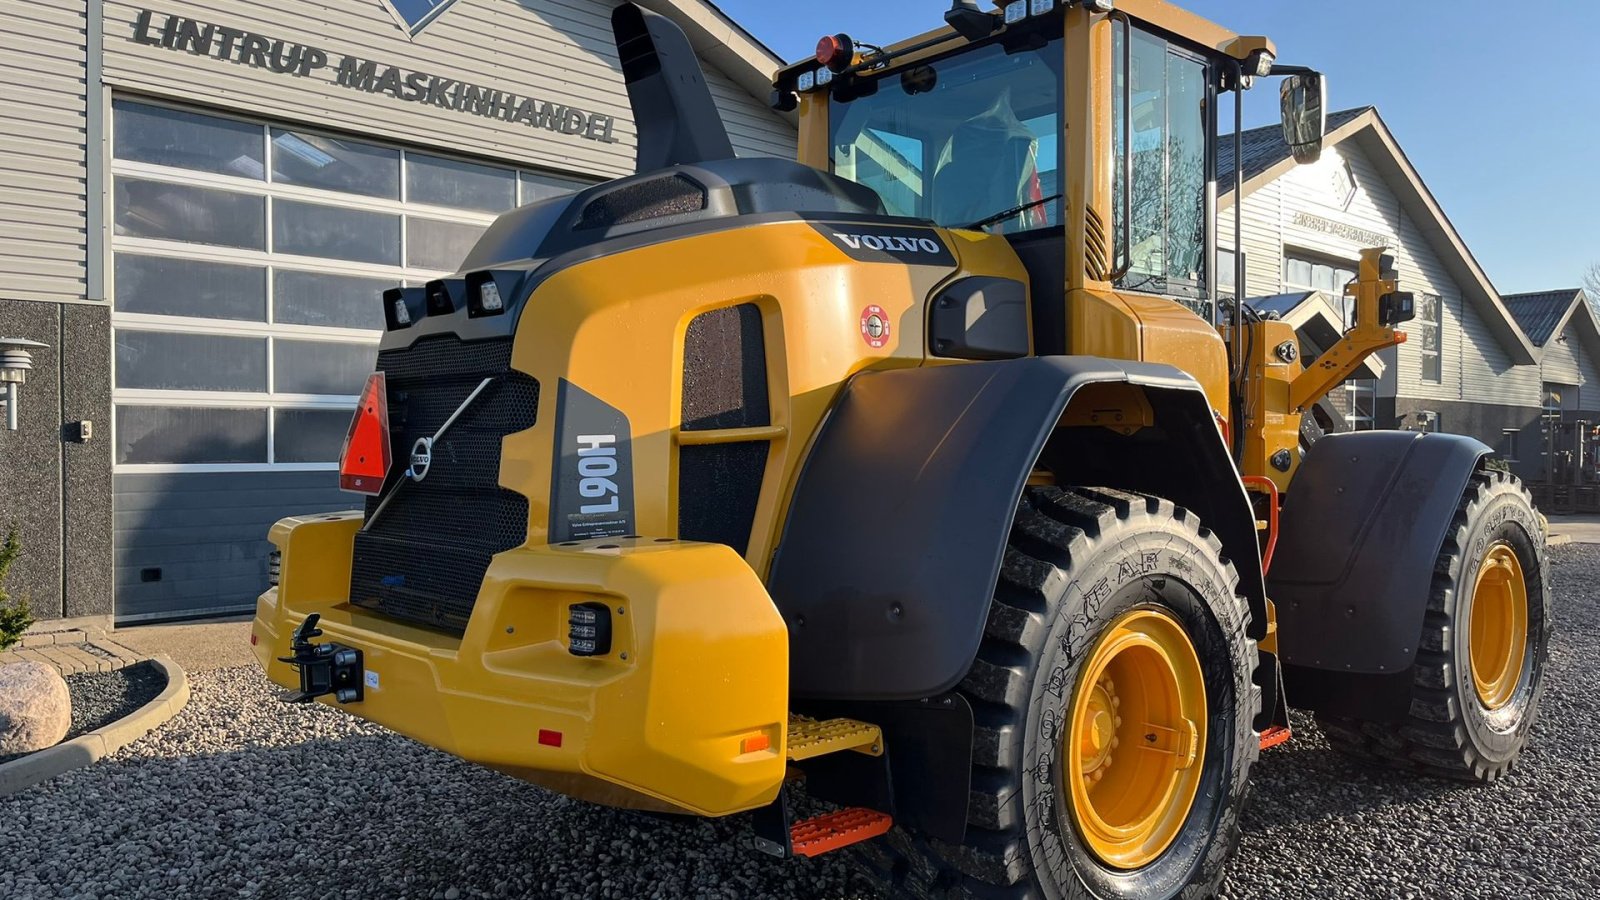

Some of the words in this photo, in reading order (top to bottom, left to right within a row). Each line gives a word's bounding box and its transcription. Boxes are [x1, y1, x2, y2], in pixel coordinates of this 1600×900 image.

[134, 10, 327, 77] LINTRUP
[338, 55, 617, 143] MASKINHANDEL
[832, 233, 940, 254] VOLVO
[576, 434, 619, 514] L90H
